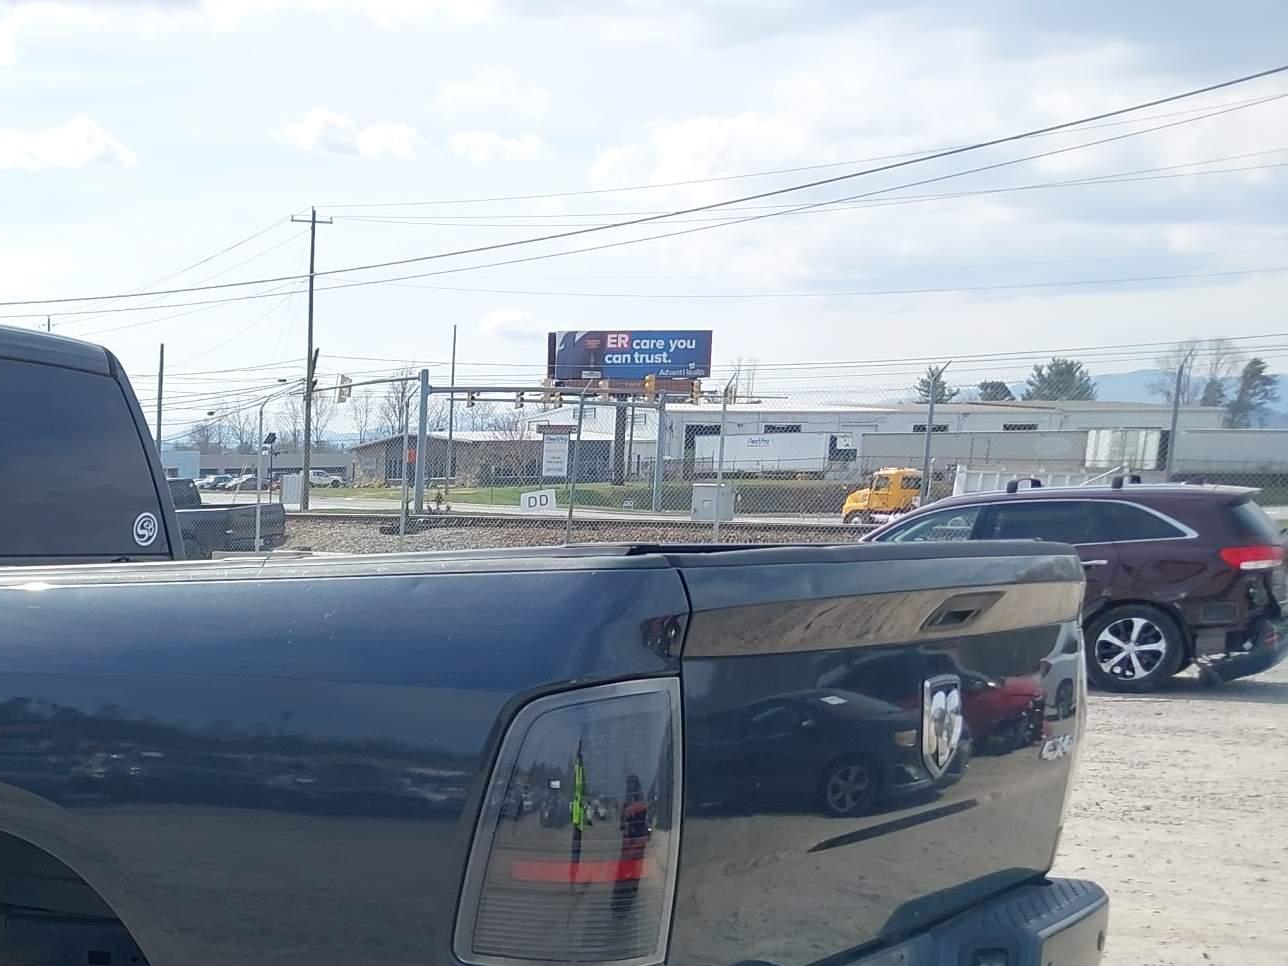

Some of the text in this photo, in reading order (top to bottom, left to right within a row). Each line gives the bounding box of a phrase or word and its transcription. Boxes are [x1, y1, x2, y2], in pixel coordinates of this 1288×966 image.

[606, 333, 629, 348] ER
[632, 339, 665, 349] care
[668, 339, 696, 352] you
[604, 352, 672, 364] can trust.
